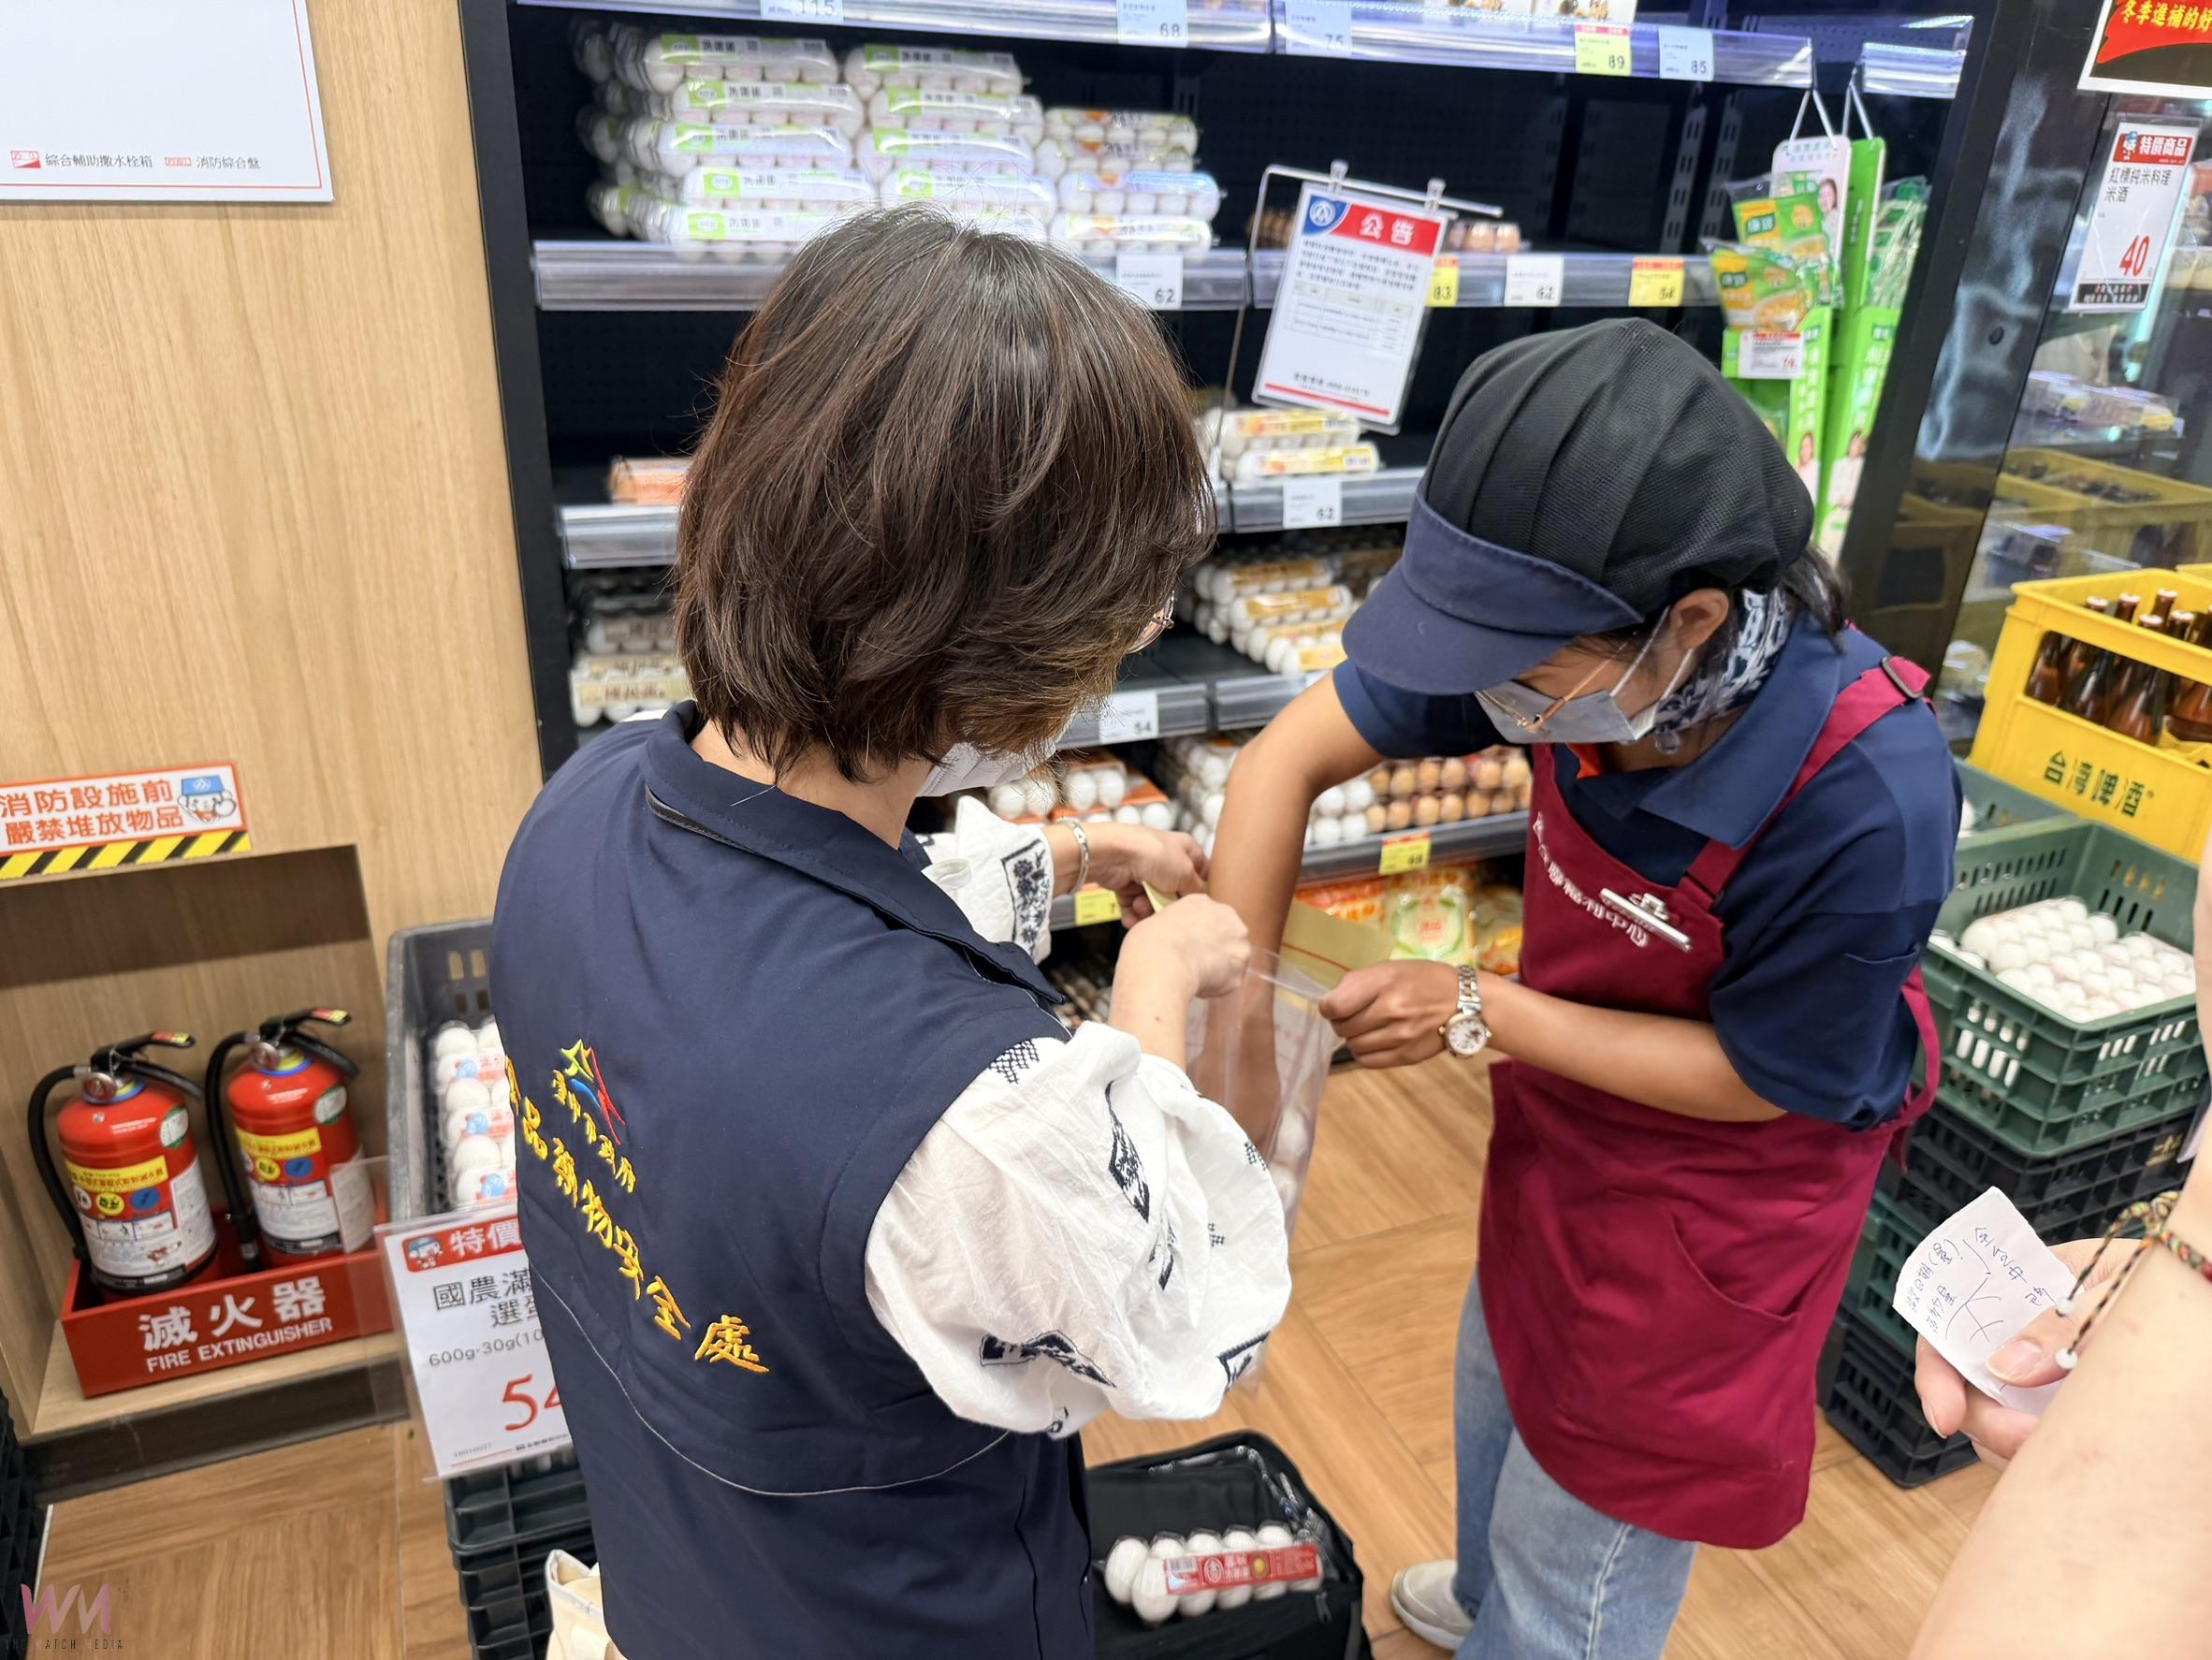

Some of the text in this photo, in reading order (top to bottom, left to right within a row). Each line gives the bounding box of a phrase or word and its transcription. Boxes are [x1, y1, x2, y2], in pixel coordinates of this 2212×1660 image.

[1361, 211, 1416, 247] 公告
[2119, 235, 2149, 276] 40
[0, 779, 175, 818] 消防設施前
[6, 805, 184, 845] 嚴禁堆放物品
[138, 1275, 326, 1352] 滅火器
[147, 1317, 333, 1373] FIRE EXTINGUISHER
